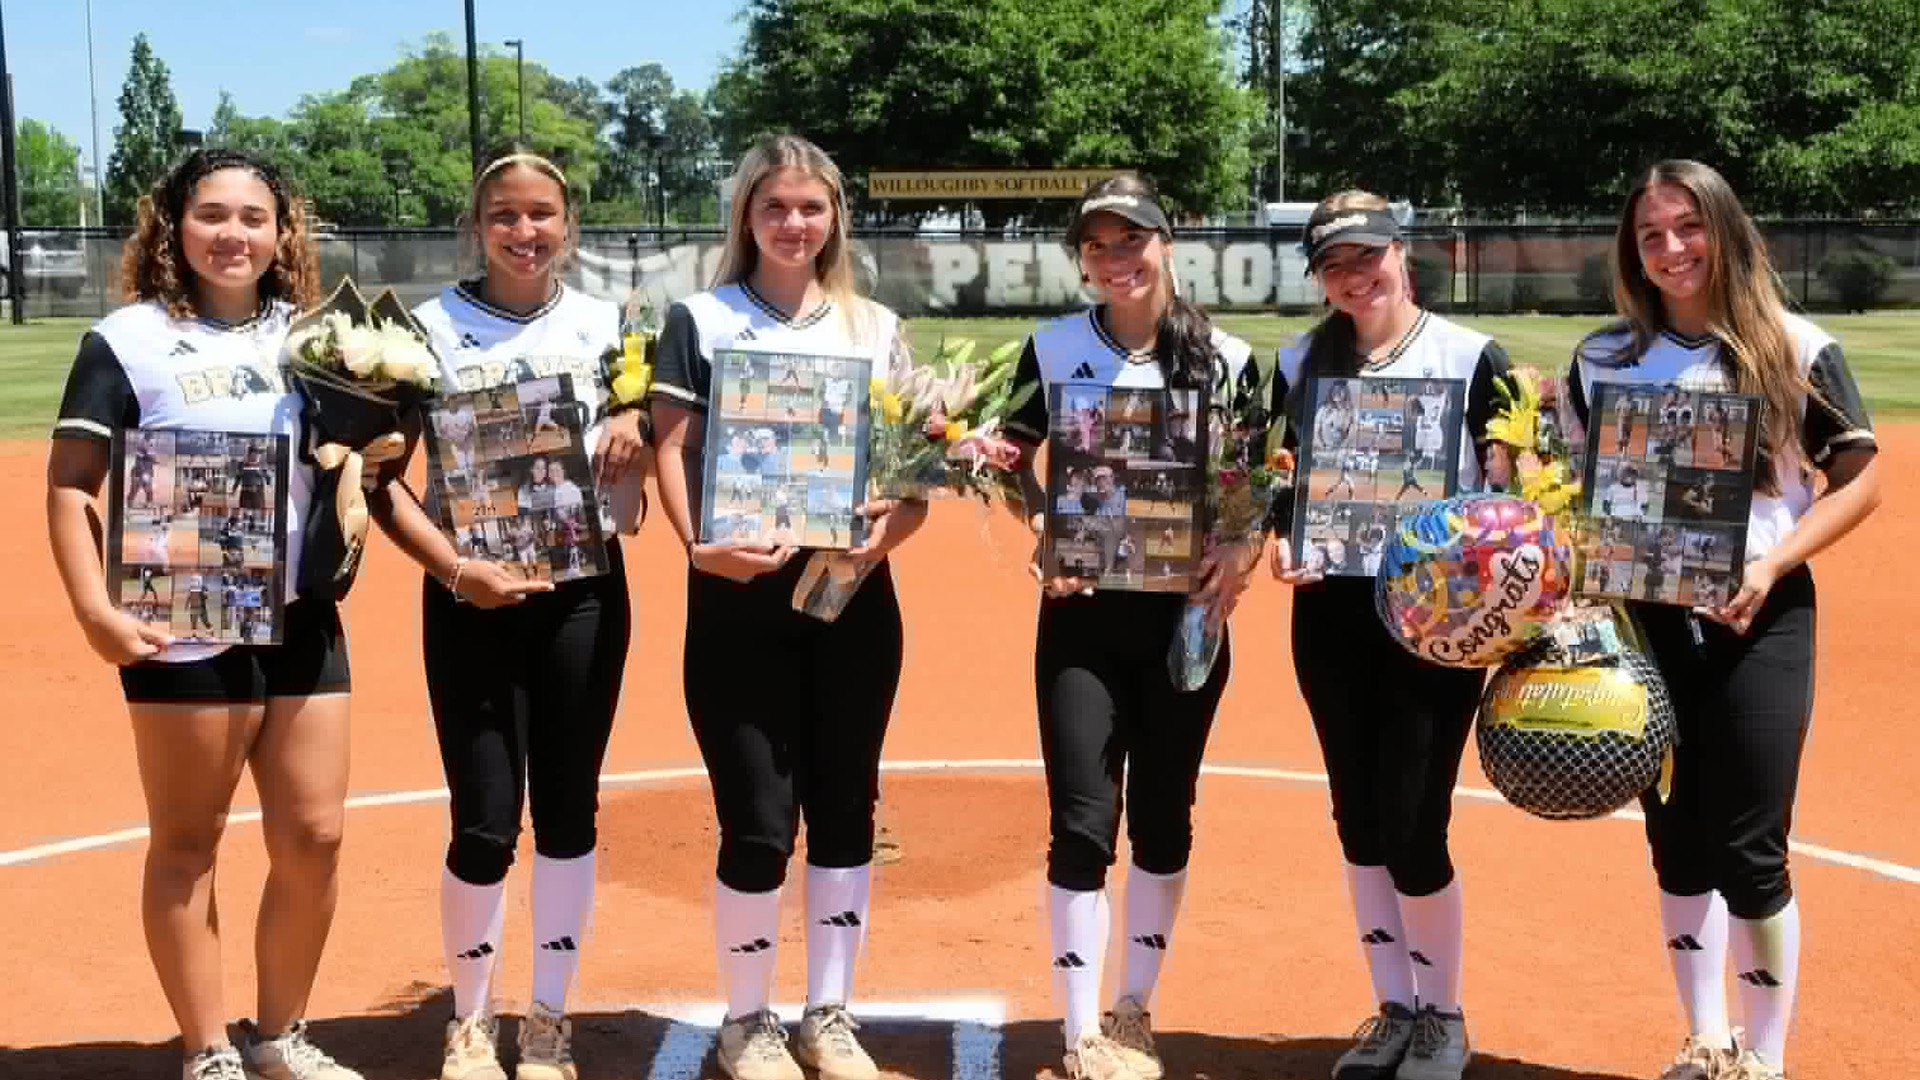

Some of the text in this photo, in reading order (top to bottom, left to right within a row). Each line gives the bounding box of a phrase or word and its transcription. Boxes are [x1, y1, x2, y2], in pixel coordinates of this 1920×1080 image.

[872, 177, 988, 193] WILLOUGHBY
[994, 177, 1082, 191] SOFTBALL
[1430, 550, 1541, 663] Congrats
